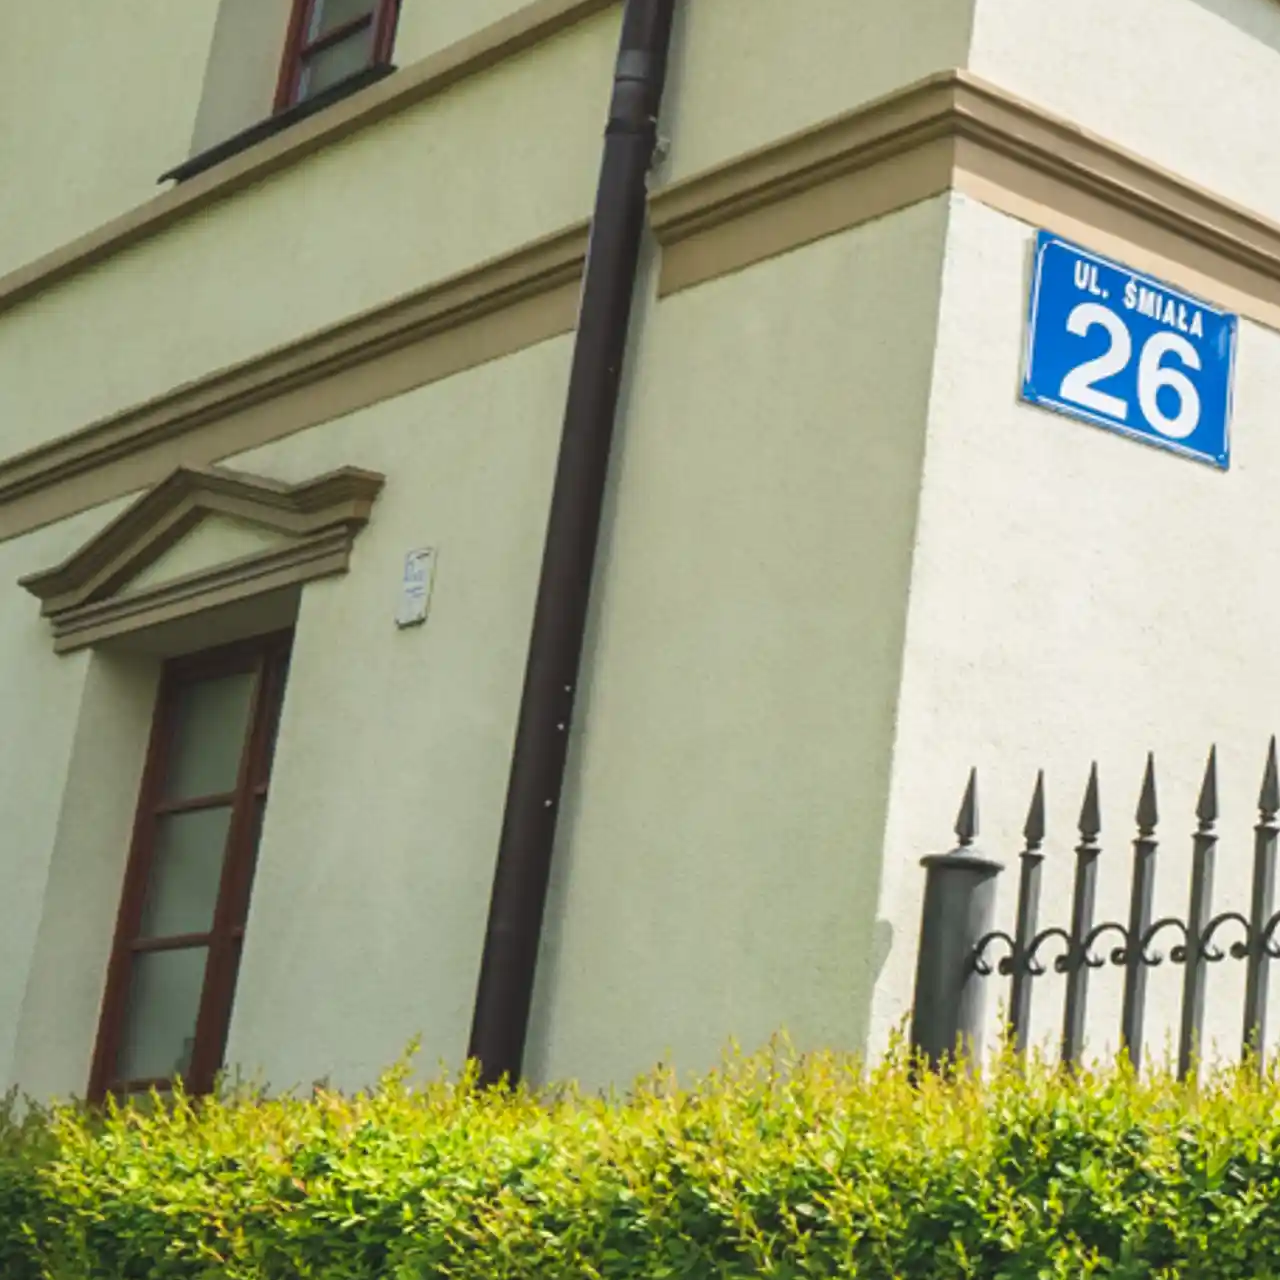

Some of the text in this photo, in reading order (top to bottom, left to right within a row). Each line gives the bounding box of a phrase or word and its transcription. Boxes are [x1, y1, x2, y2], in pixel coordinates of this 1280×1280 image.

[1074, 260, 1204, 338] UL. ŚMIAŁA
[1059, 302, 1202, 439] 26
